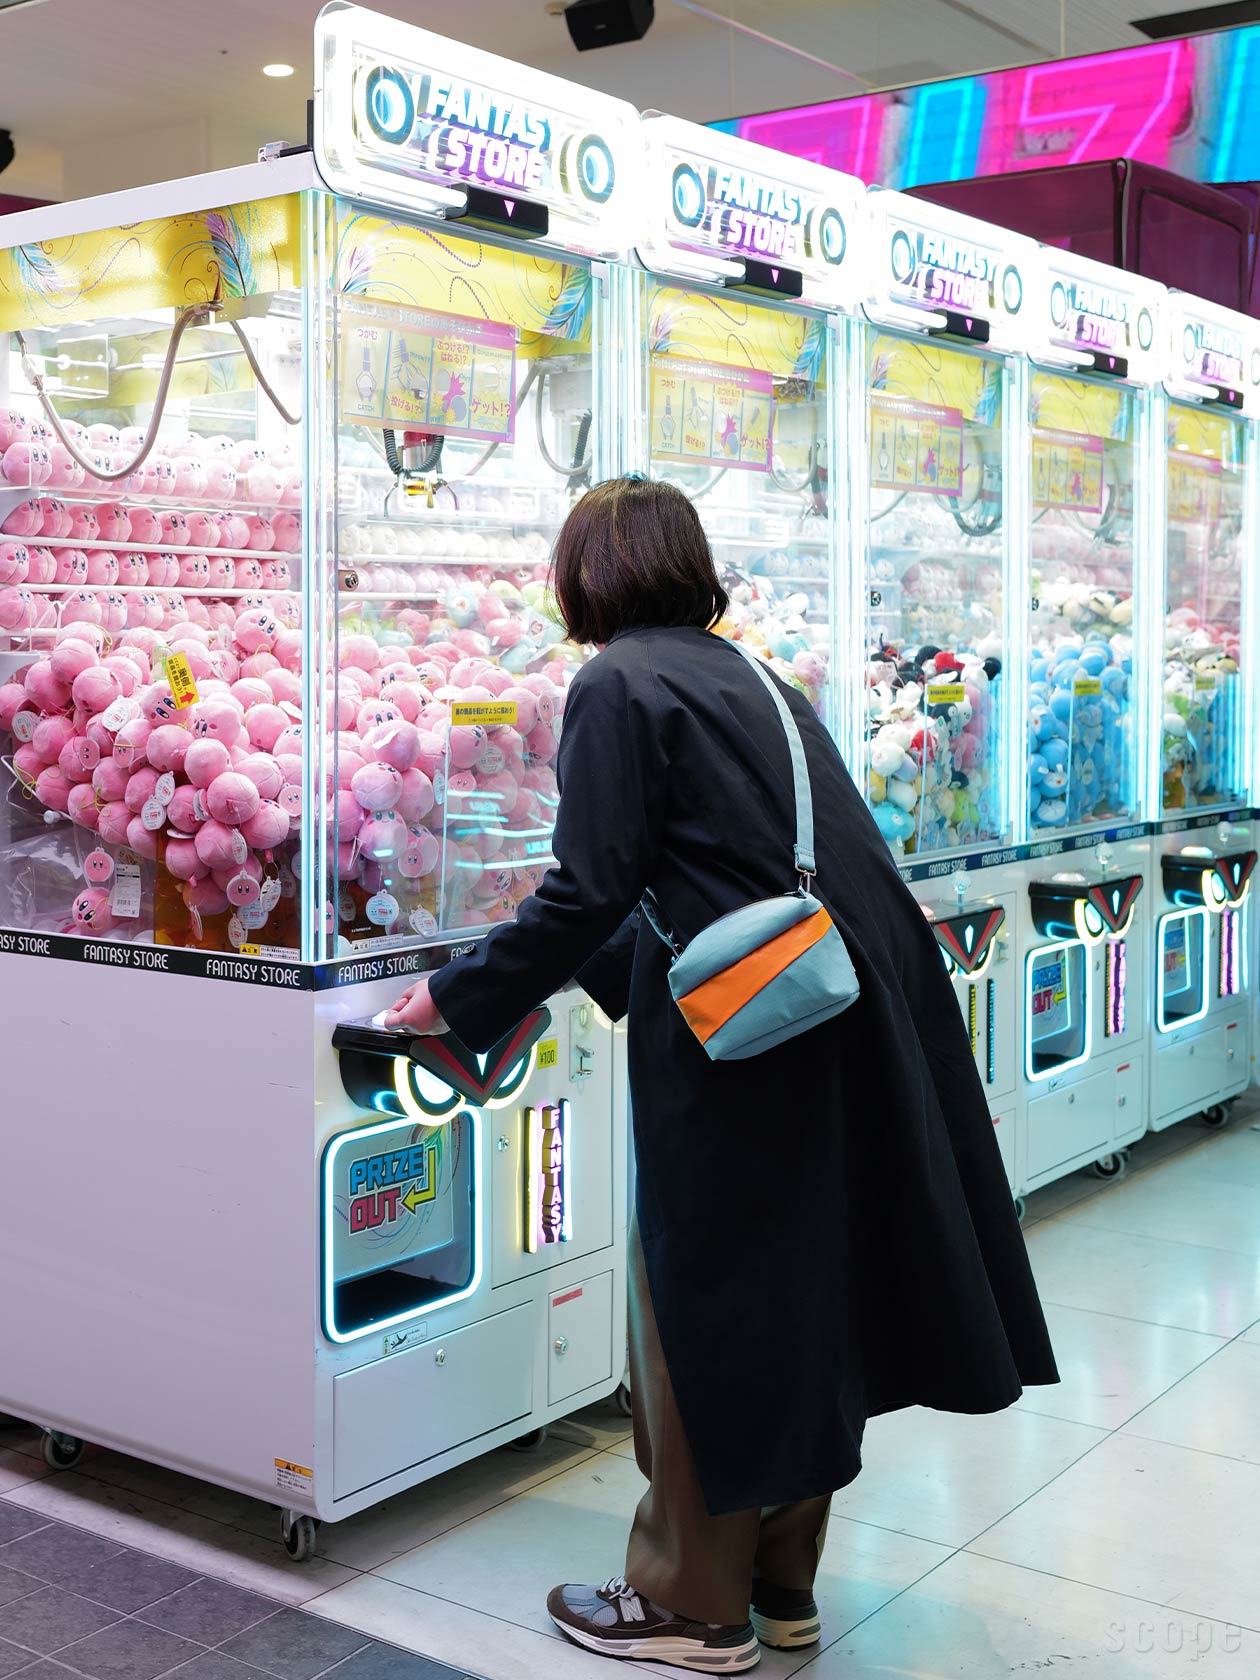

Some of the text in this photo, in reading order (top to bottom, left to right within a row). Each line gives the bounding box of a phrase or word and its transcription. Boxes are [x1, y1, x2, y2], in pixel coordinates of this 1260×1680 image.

[426, 76, 564, 153] FANTASY
[445, 128, 545, 188] STORE
[713, 167, 810, 226] FANTASY
[727, 209, 796, 257] STORE
[470, 399, 511, 418] ゲット!?
[929, 861, 950, 877] FANTASY
[18, 936, 50, 955] STORE
[84, 944, 169, 970] FANTASY STORE
[206, 958, 300, 986] FANTASY STORE
[338, 954, 420, 984] FANTASY STORE
[1033, 989, 1052, 1015] OUT
[540, 1049, 555, 1065] ¥100
[350, 1144, 424, 1196] PRIZE
[547, 1106, 562, 1243] FANTASY
[350, 1186, 401, 1234] OUT
[619, 1597, 645, 1622] N
